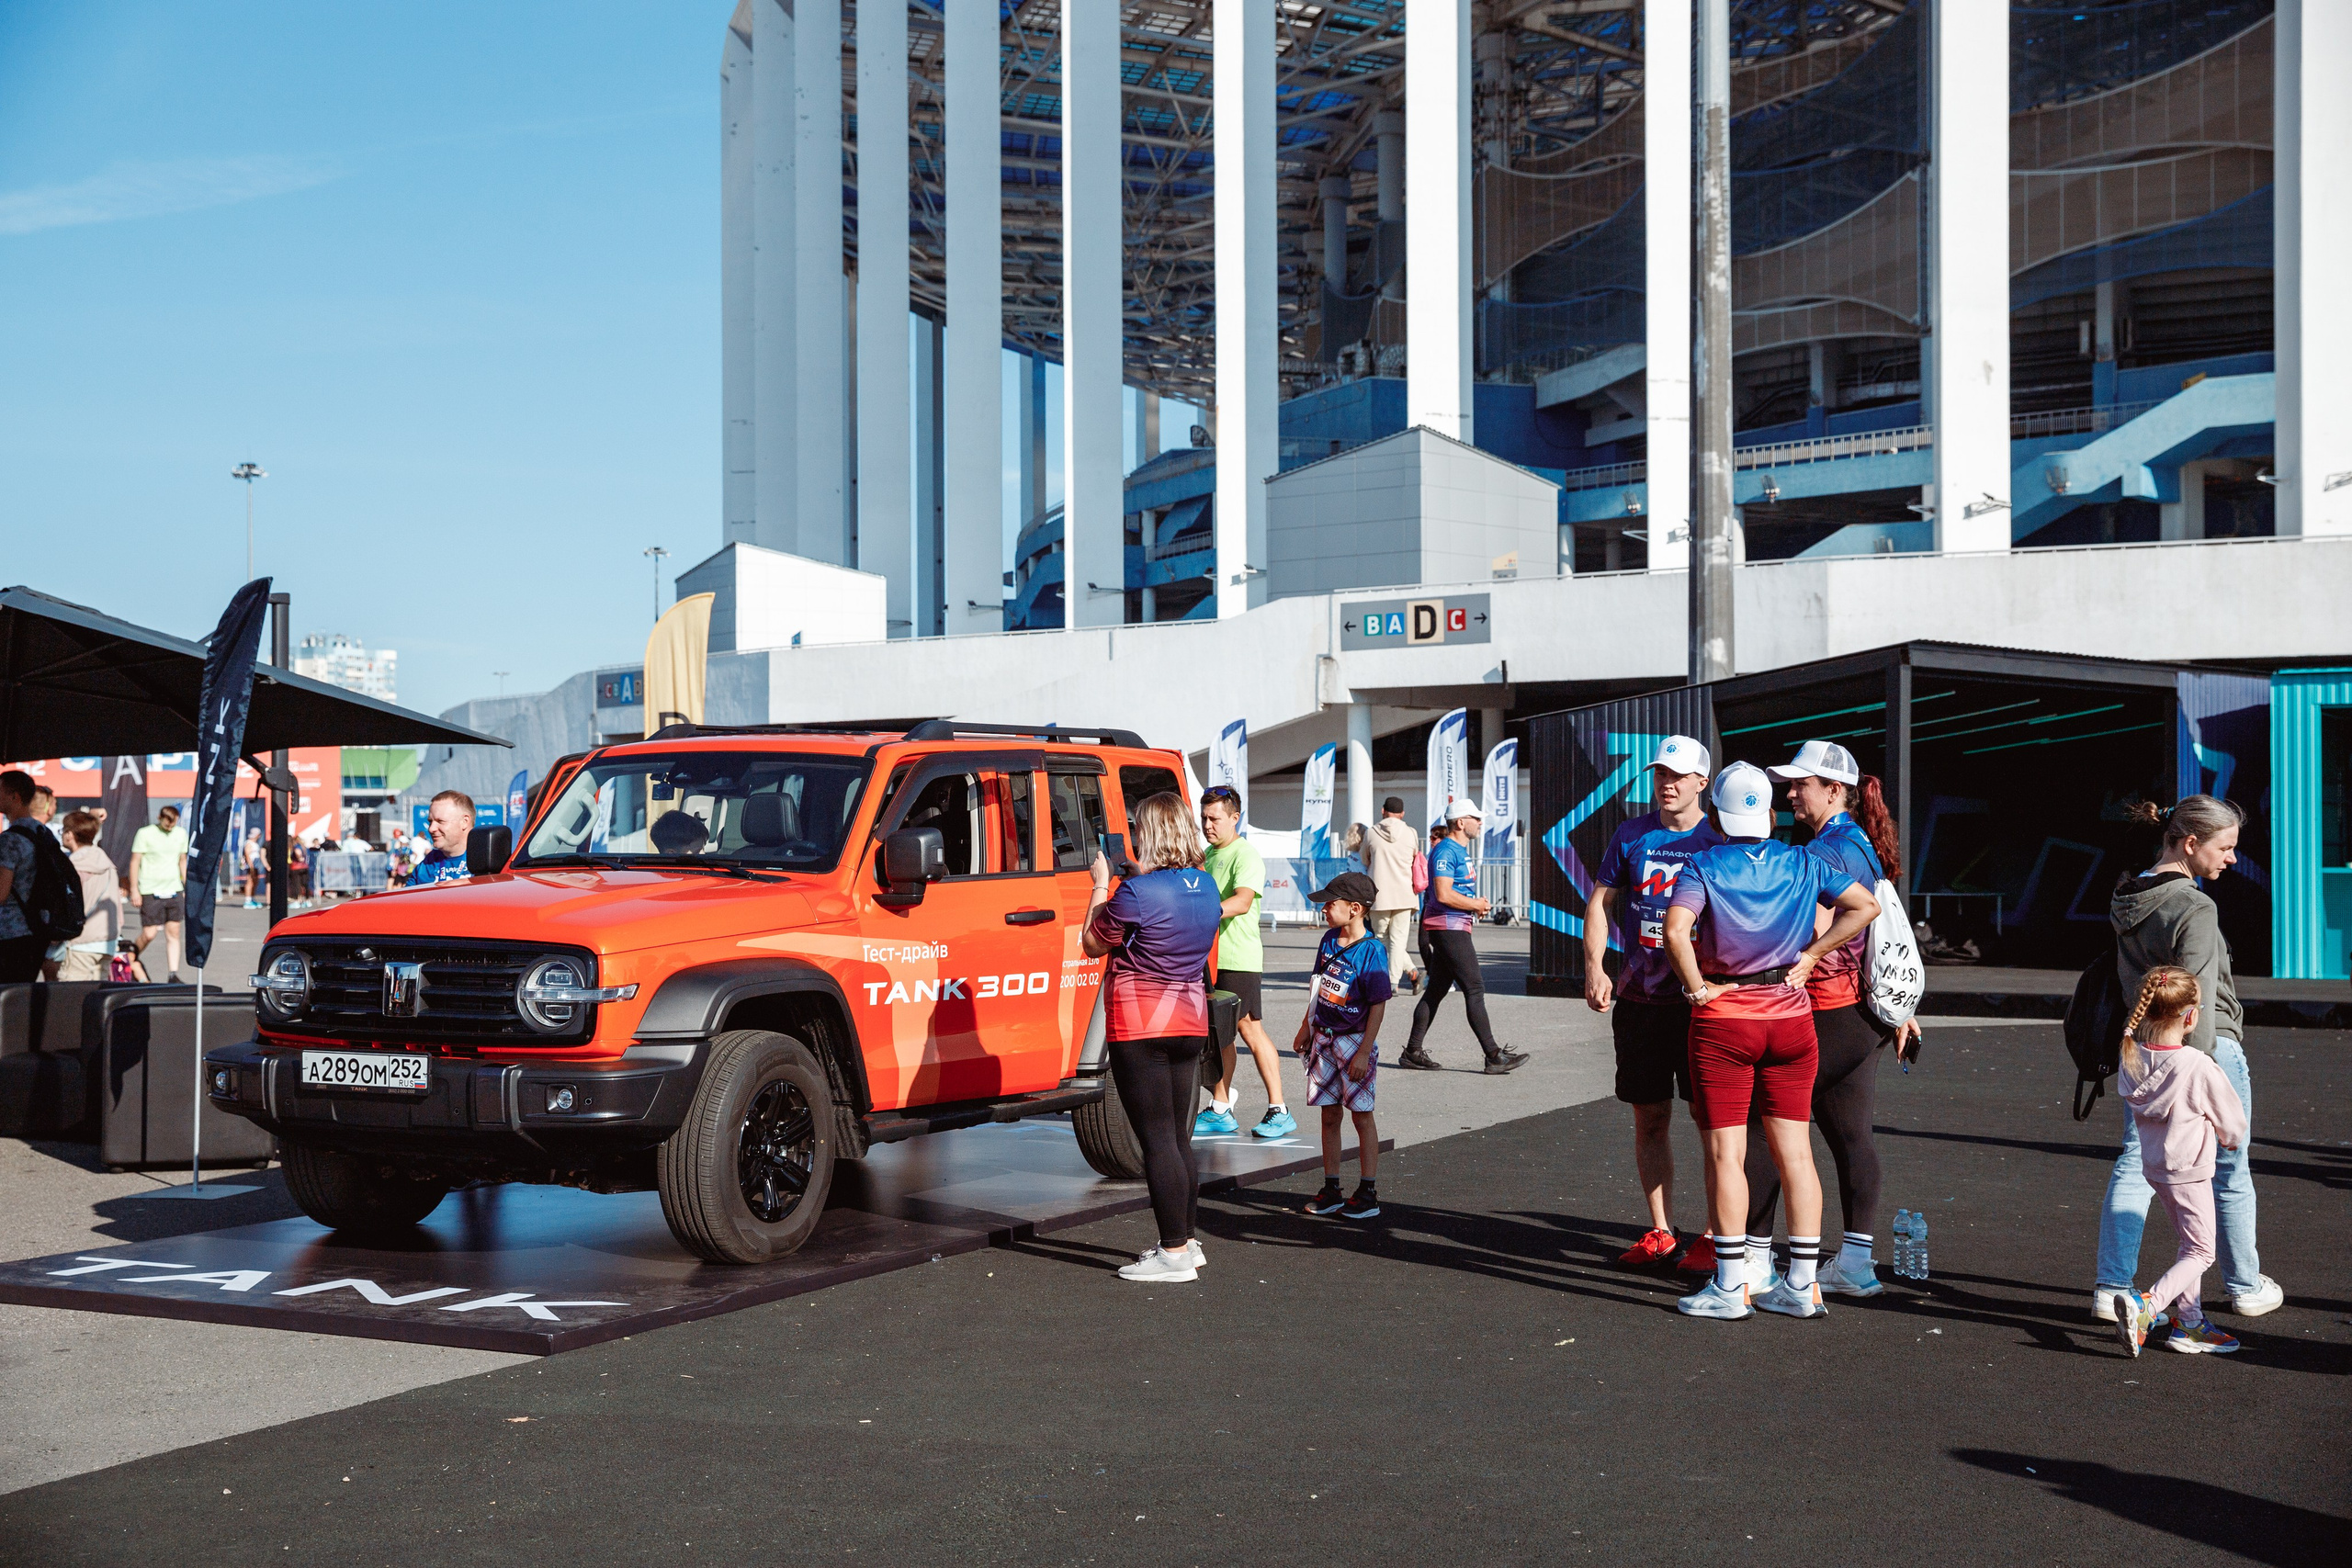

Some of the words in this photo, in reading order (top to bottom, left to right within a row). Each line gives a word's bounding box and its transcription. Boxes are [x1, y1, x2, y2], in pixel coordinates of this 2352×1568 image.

[1367, 615, 1380, 635] B
[1388, 615, 1402, 633] A
[1414, 604, 1437, 639] D
[1450, 610, 1463, 629] C
[621, 675, 632, 702] A
[1445, 746, 1453, 794] TORERO
[1646, 849, 1696, 859] МАРАФО
[863, 941, 948, 964] Тест-драйв
[863, 977, 968, 1006] TANK
[975, 971, 1050, 998] 300
[1077, 973, 1088, 987] 02
[1089, 972, 1100, 986] 02
[390, 1058, 422, 1079] 252
[398, 1079, 414, 1088] RUS
[46, 1256, 631, 1322] TANK
